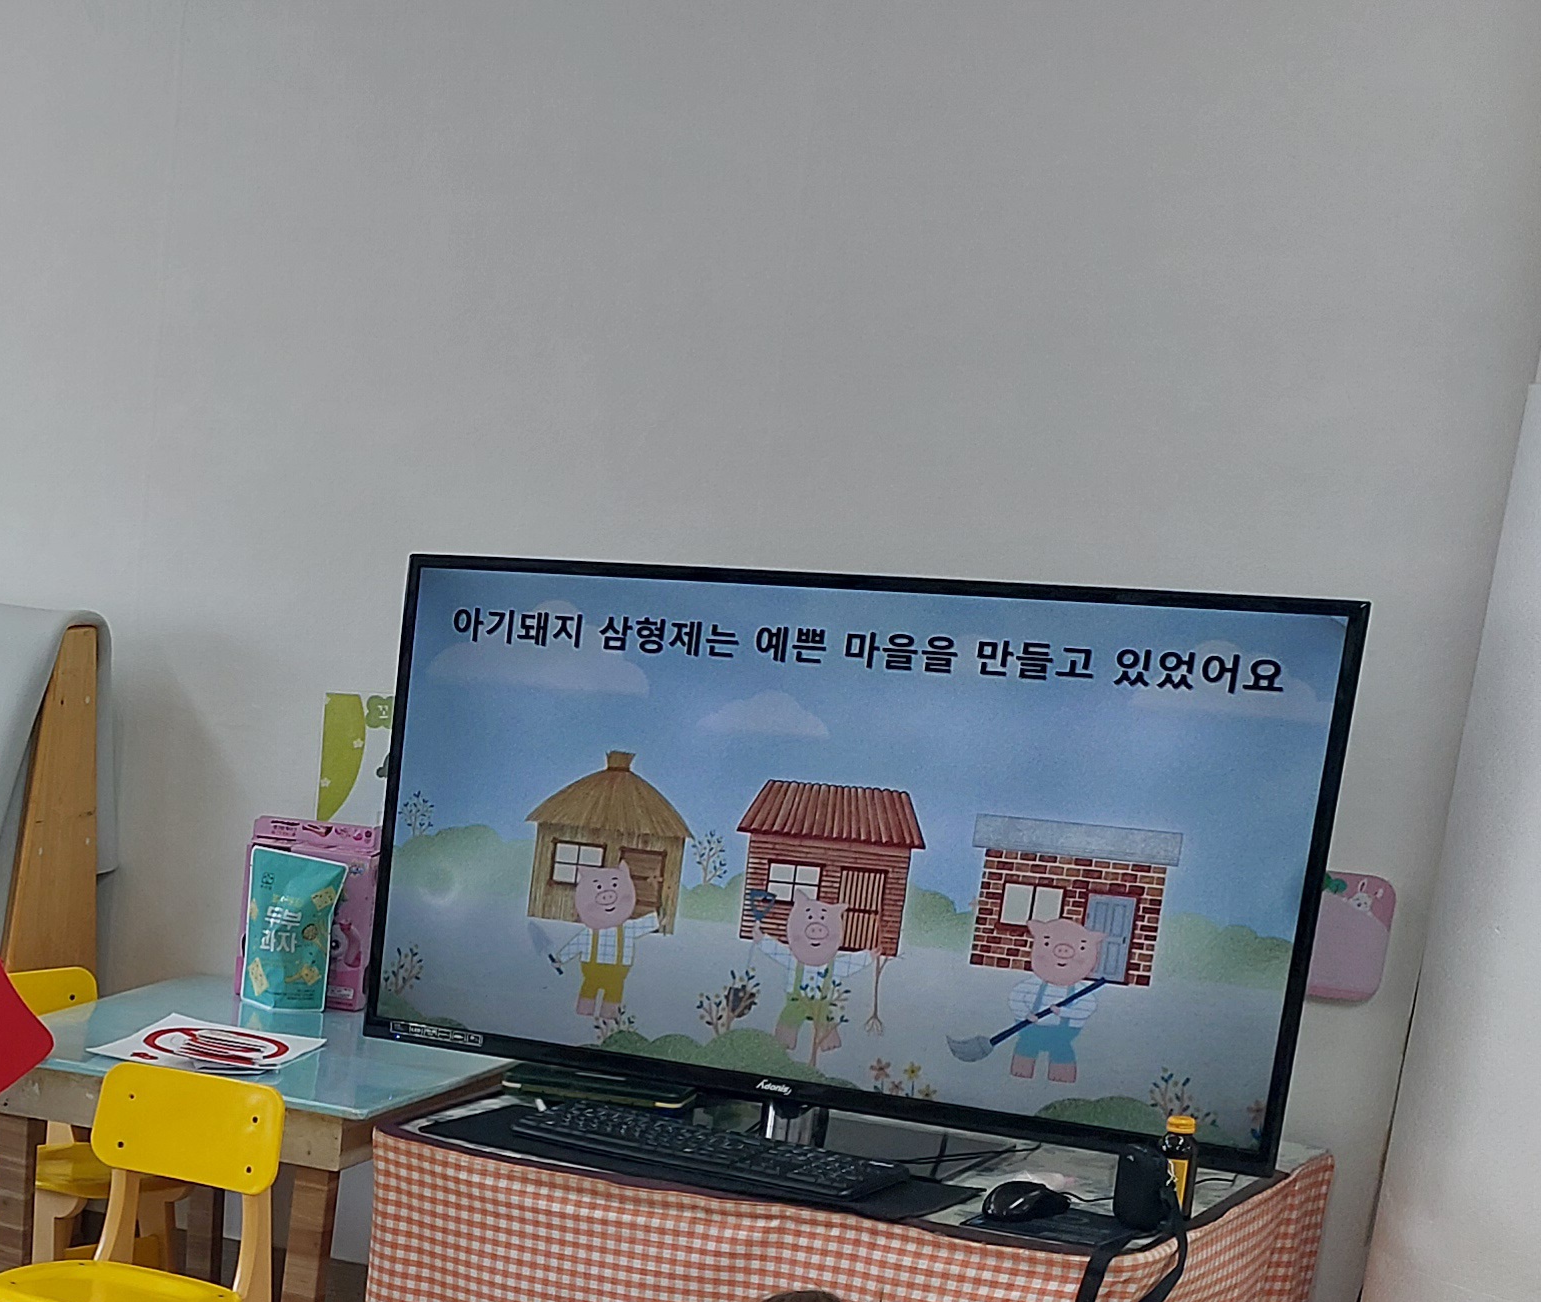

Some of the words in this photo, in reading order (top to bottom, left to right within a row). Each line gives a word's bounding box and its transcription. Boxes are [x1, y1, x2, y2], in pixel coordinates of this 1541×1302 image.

[452, 607, 584, 649] 아기돼지
[598, 616, 740, 658] 삼형제는
[755, 626, 828, 665] 예쁜
[844, 631, 959, 674] 마을을
[976, 640, 1095, 681] 만들고
[1113, 648, 1285, 695] 있었어요
[264, 906, 302, 929] 두부
[260, 930, 298, 953] 과자
